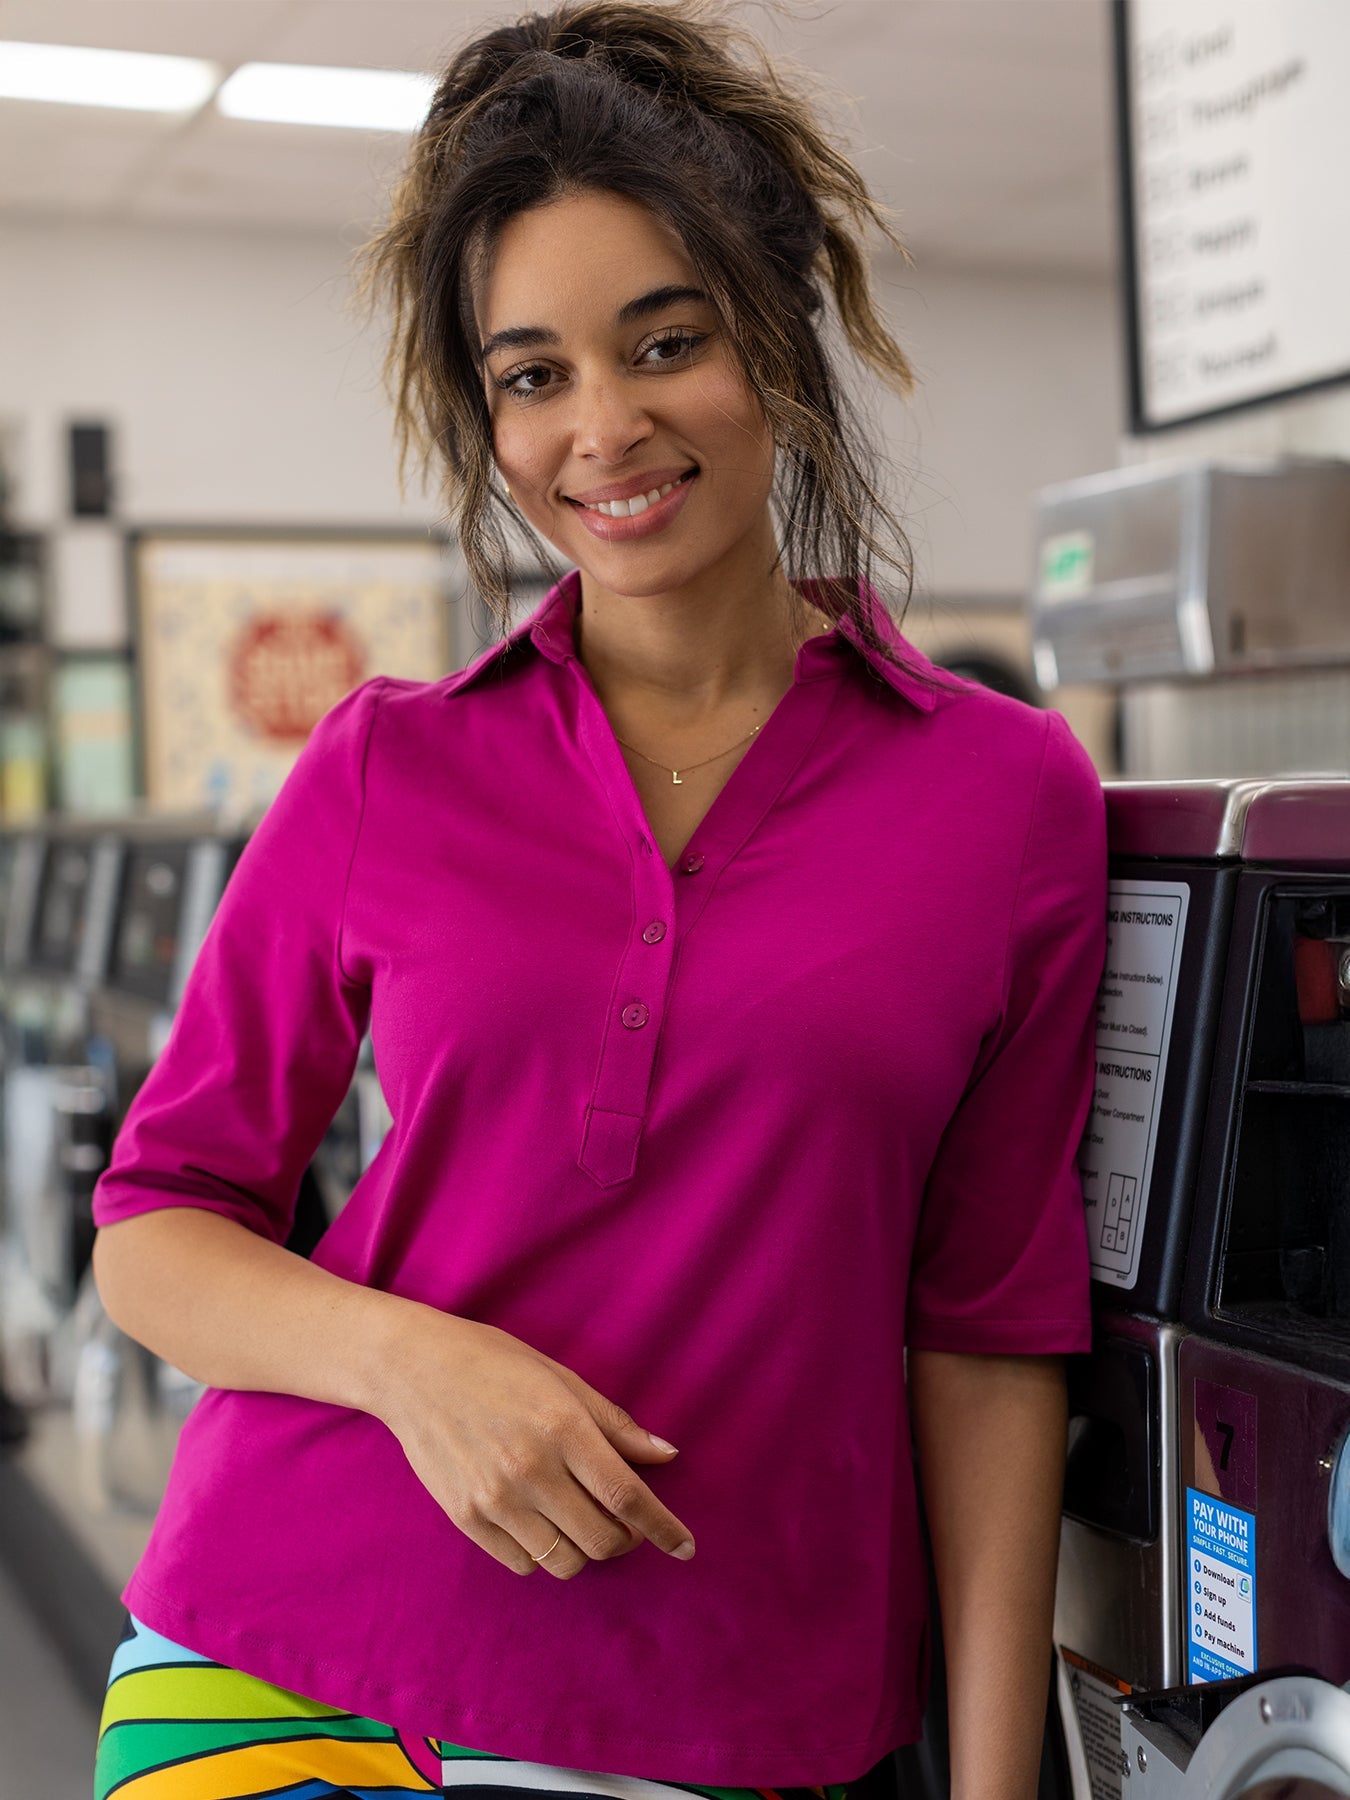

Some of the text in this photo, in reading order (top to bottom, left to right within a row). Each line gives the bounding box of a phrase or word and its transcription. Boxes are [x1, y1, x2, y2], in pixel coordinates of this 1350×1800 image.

[672, 771, 683, 784] L
[1120, 911, 1174, 926] INSTRUCTIONS
[1099, 1063, 1152, 1082] INSTRUCTIONS
[1112, 1108, 1145, 1123] Compartment
[1111, 1198, 1117, 1207] D
[1125, 1194, 1130, 1203] A
[1106, 1233, 1112, 1243] C
[1120, 1231, 1125, 1241] B
[1216, 1421, 1234, 1471] 7
[1193, 1499, 1248, 1538] PAY WITH
[1193, 1517, 1249, 1553] YOUR PHONE
[1203, 1565, 1235, 1588] Download
[1203, 1587, 1217, 1602] Sign
[1217, 1595, 1227, 1608] up
[1203, 1609, 1217, 1622] Add
[1217, 1615, 1236, 1632] funds
[1204, 1629, 1216, 1645] Pay
[1216, 1638, 1245, 1658] machine
